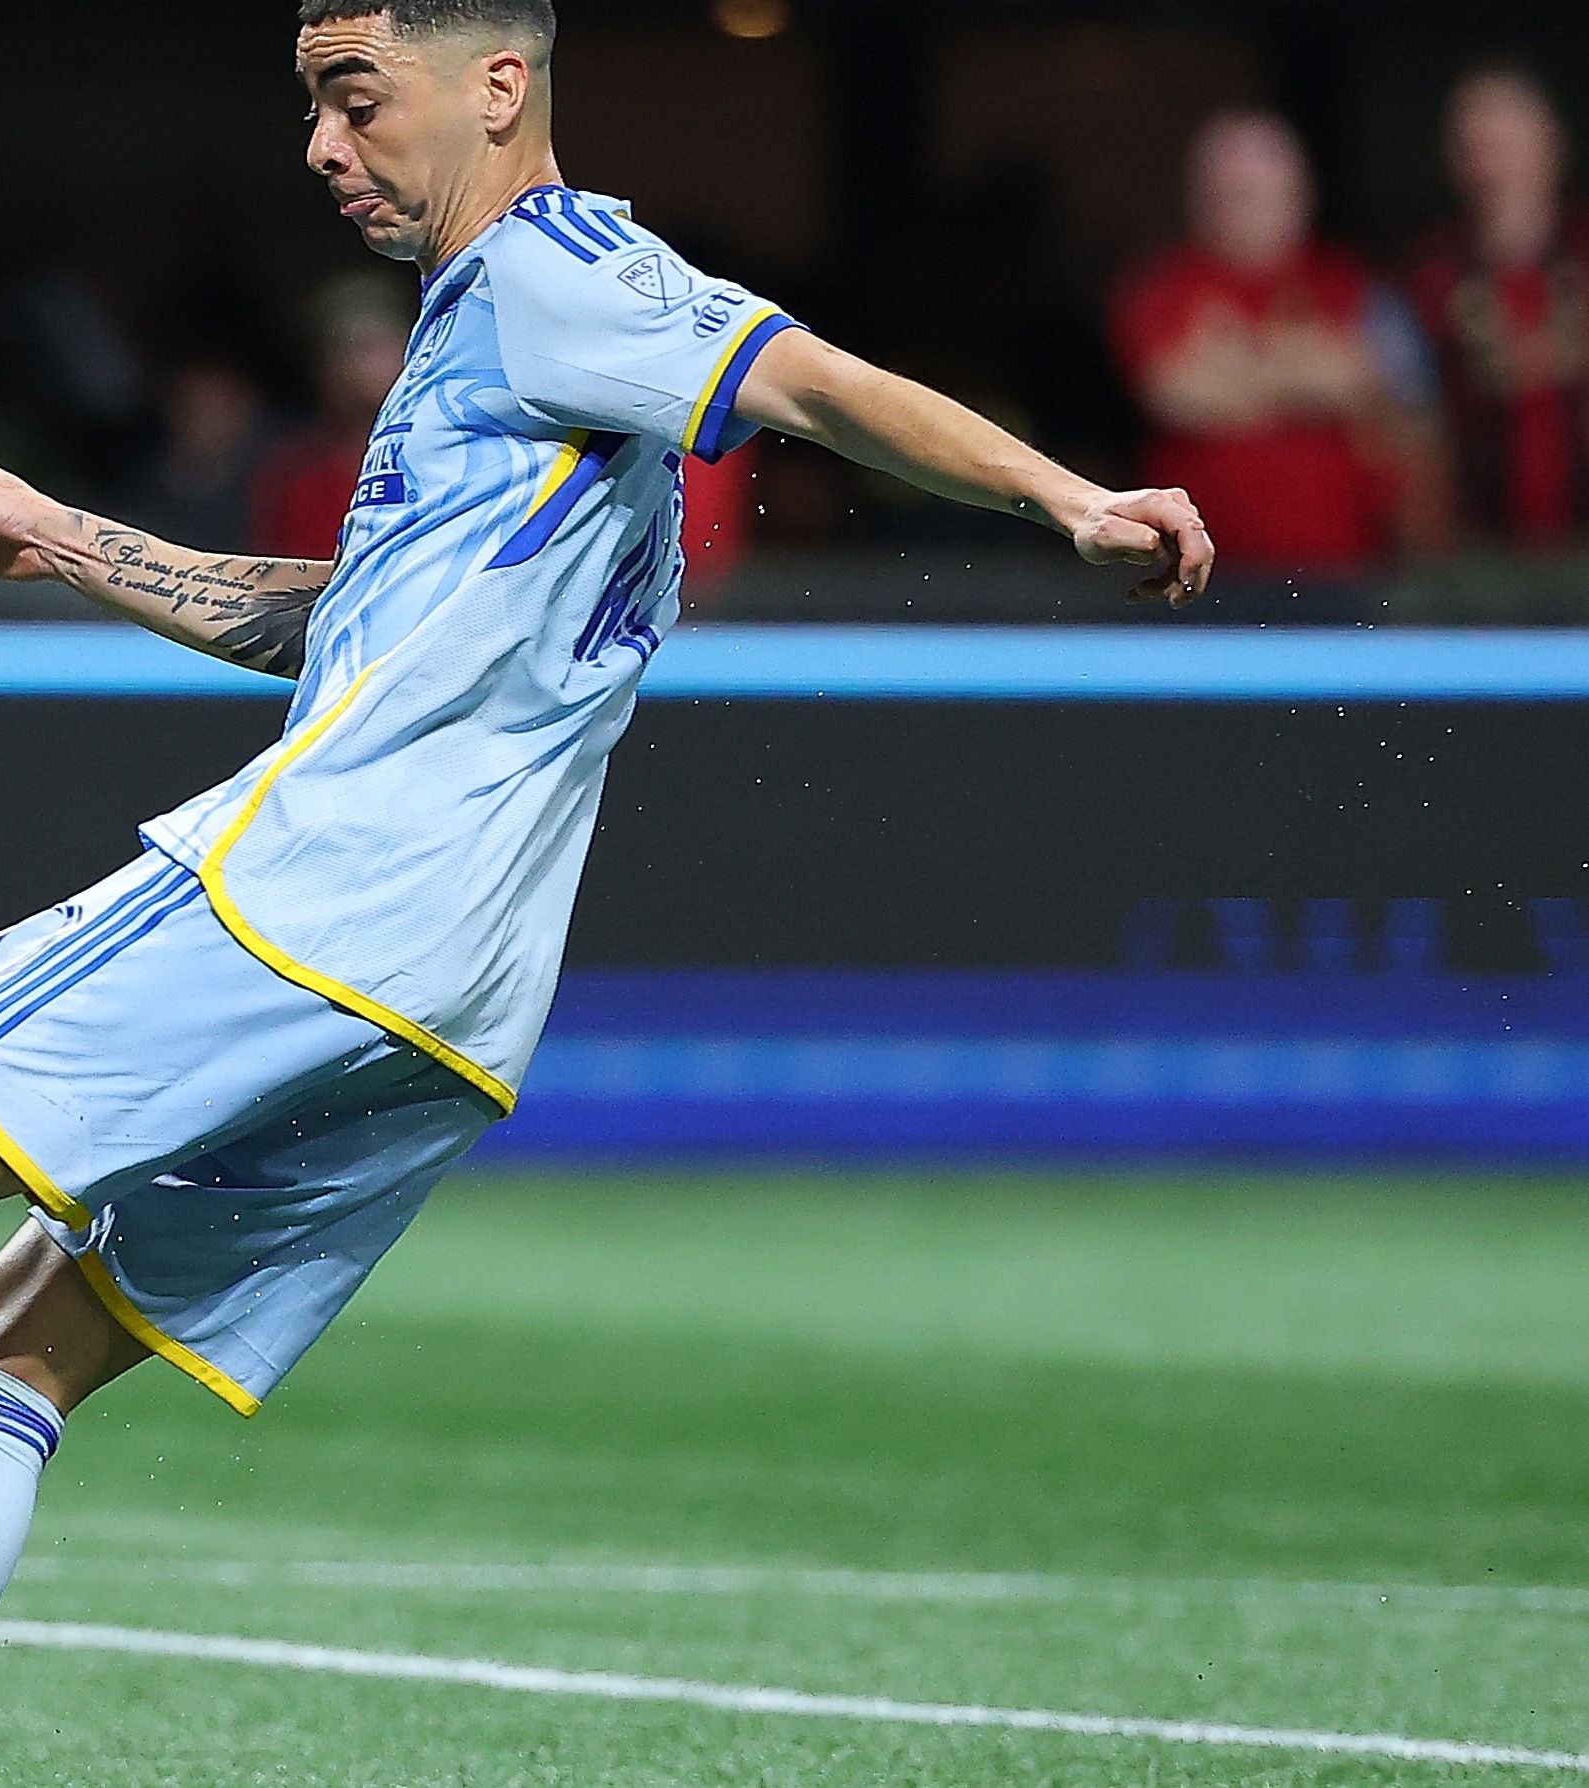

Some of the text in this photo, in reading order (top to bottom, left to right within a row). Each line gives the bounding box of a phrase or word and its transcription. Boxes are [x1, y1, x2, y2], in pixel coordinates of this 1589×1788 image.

[624, 262, 653, 282] MLS
[175, 565, 199, 578] el
[107, 567, 247, 613] la verdad y la vida
